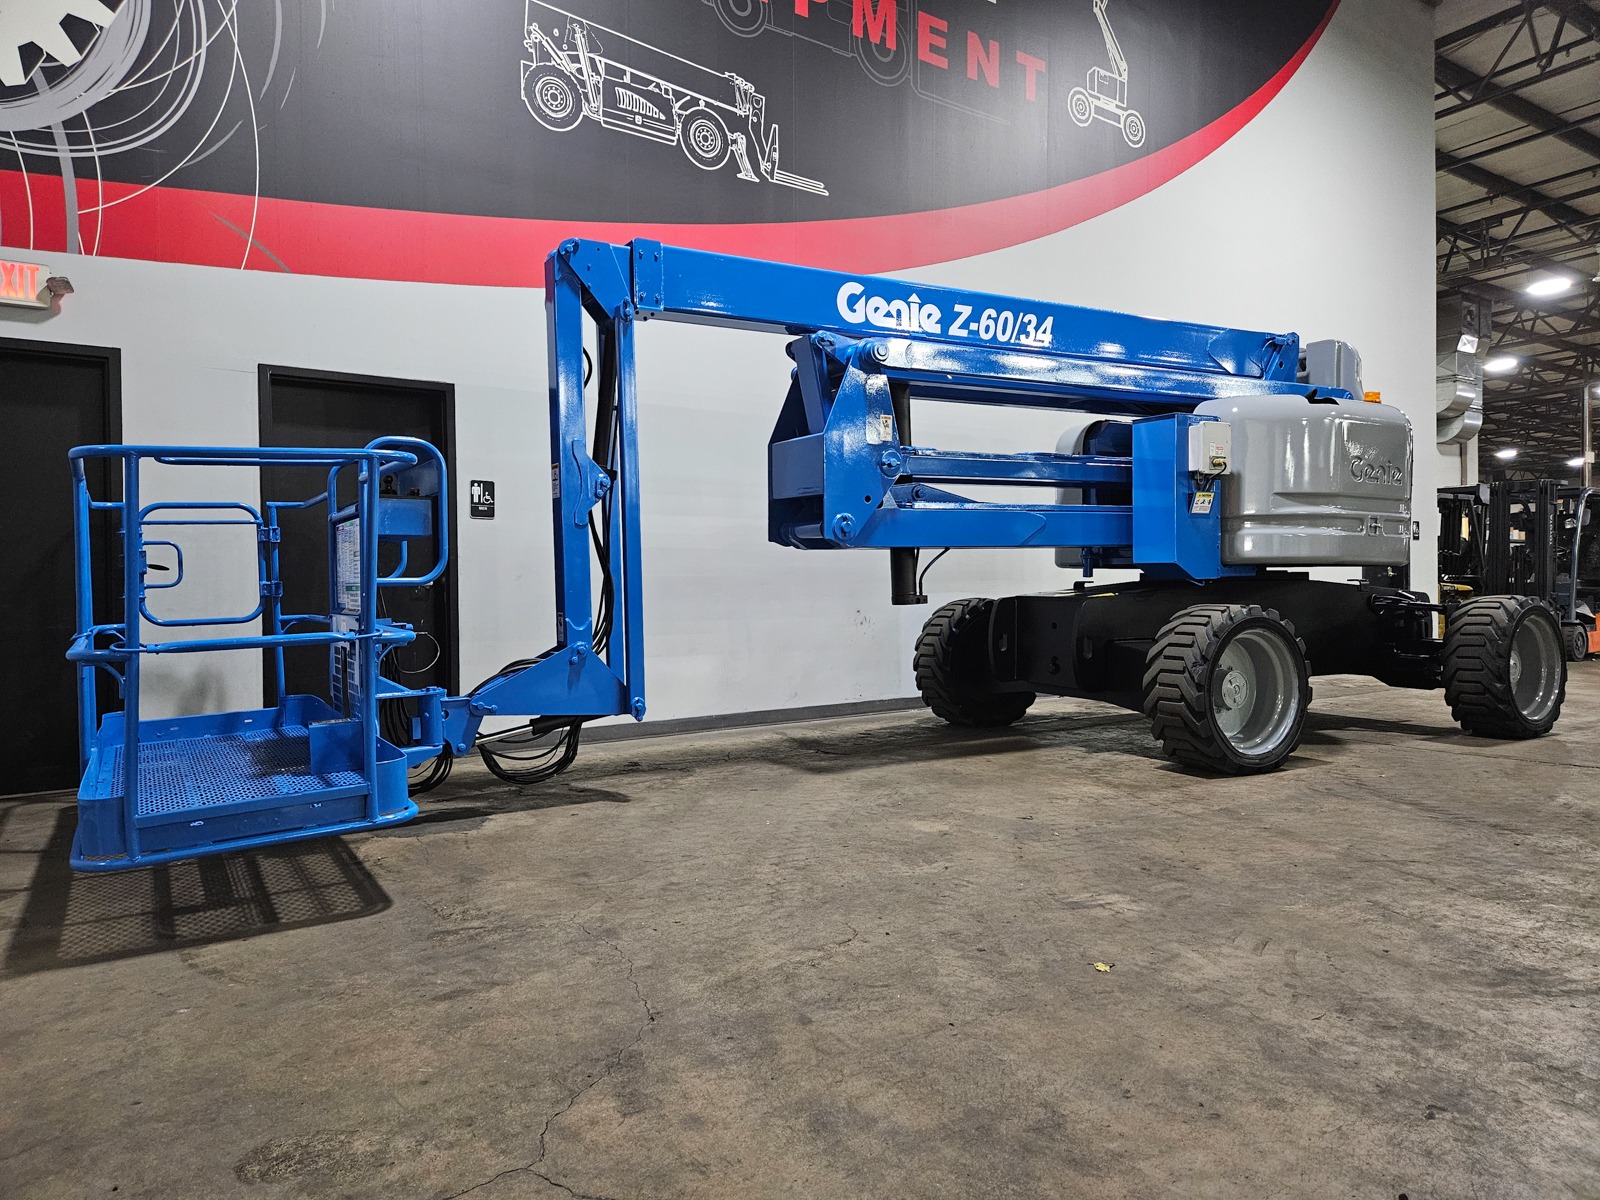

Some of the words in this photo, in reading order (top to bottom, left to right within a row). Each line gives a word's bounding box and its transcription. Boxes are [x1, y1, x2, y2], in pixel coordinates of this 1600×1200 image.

[761, 0, 1046, 102] MENT
[836, 281, 942, 334] Genie
[948, 303, 1054, 347] Z-60/34
[1351, 455, 1403, 486] Genie
